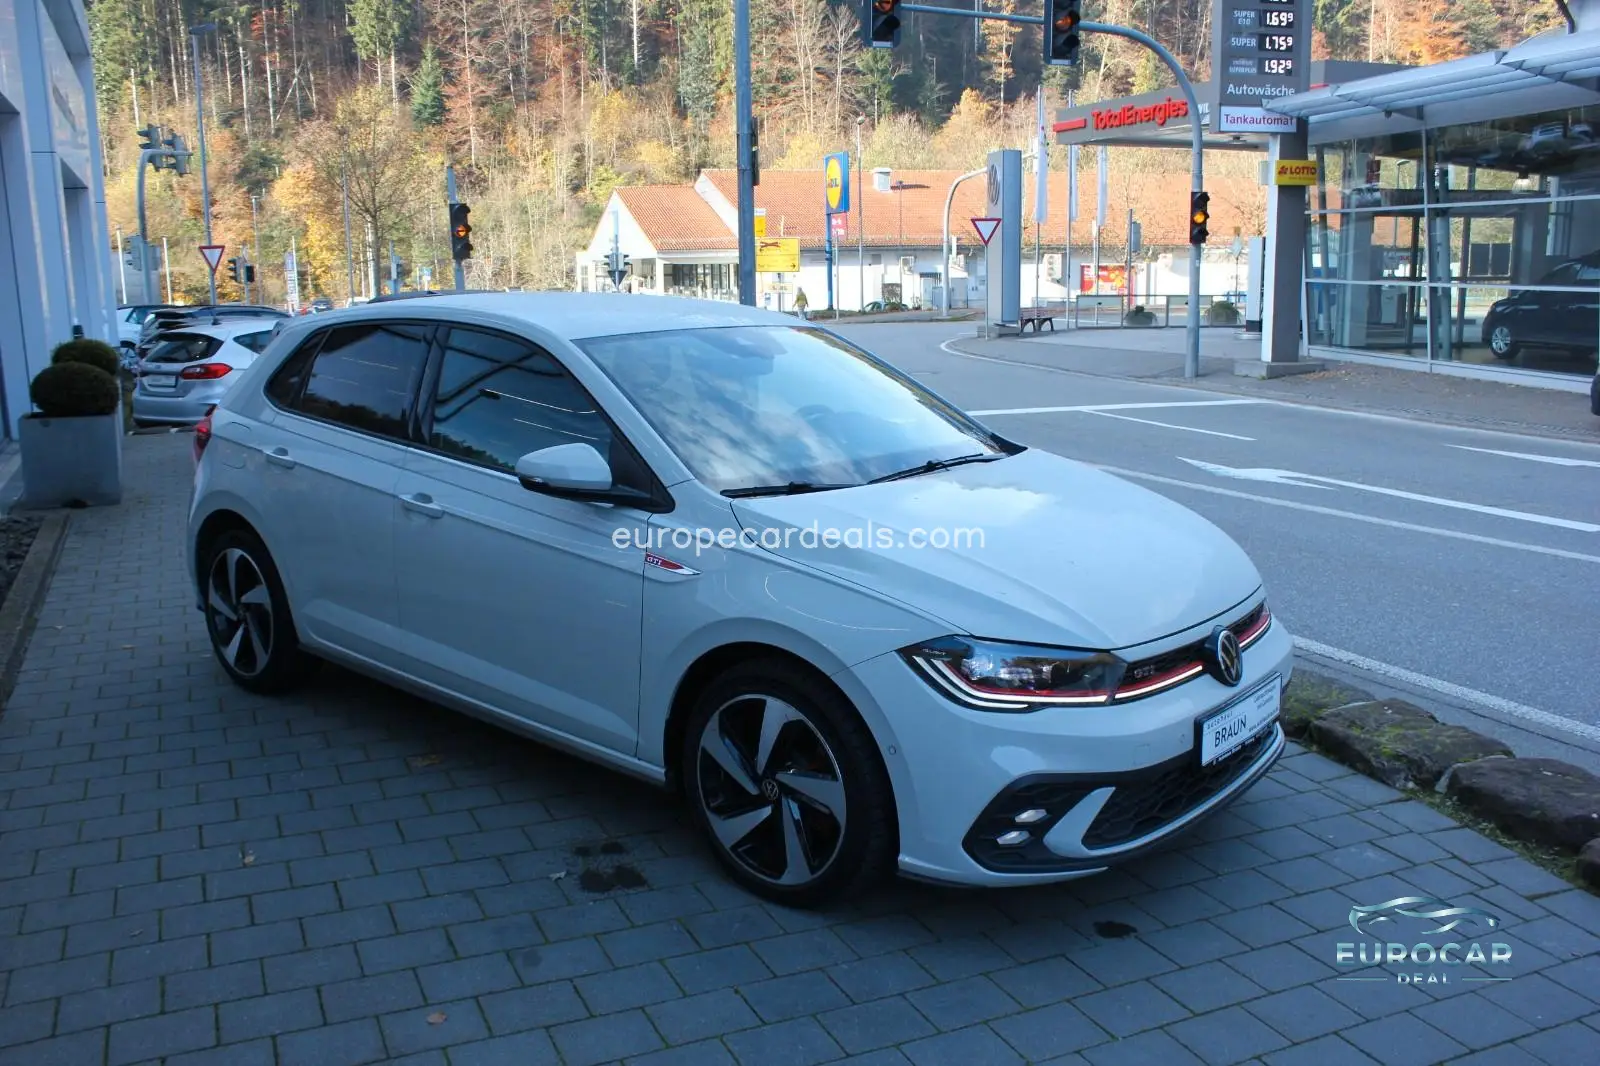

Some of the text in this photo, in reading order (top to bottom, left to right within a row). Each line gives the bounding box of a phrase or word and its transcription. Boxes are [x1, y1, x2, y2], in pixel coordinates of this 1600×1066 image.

[1233, 10, 1255, 18] SUPER
[1231, 37, 1256, 47] SUPER
[1226, 83, 1295, 97] Autowäsche
[1091, 96, 1188, 130] TotalEnergies
[1224, 113, 1294, 126] Tankautomat
[1289, 165, 1316, 175] LOTTO
[647, 556, 662, 566] GTI
[1214, 714, 1247, 748] BRAUN
